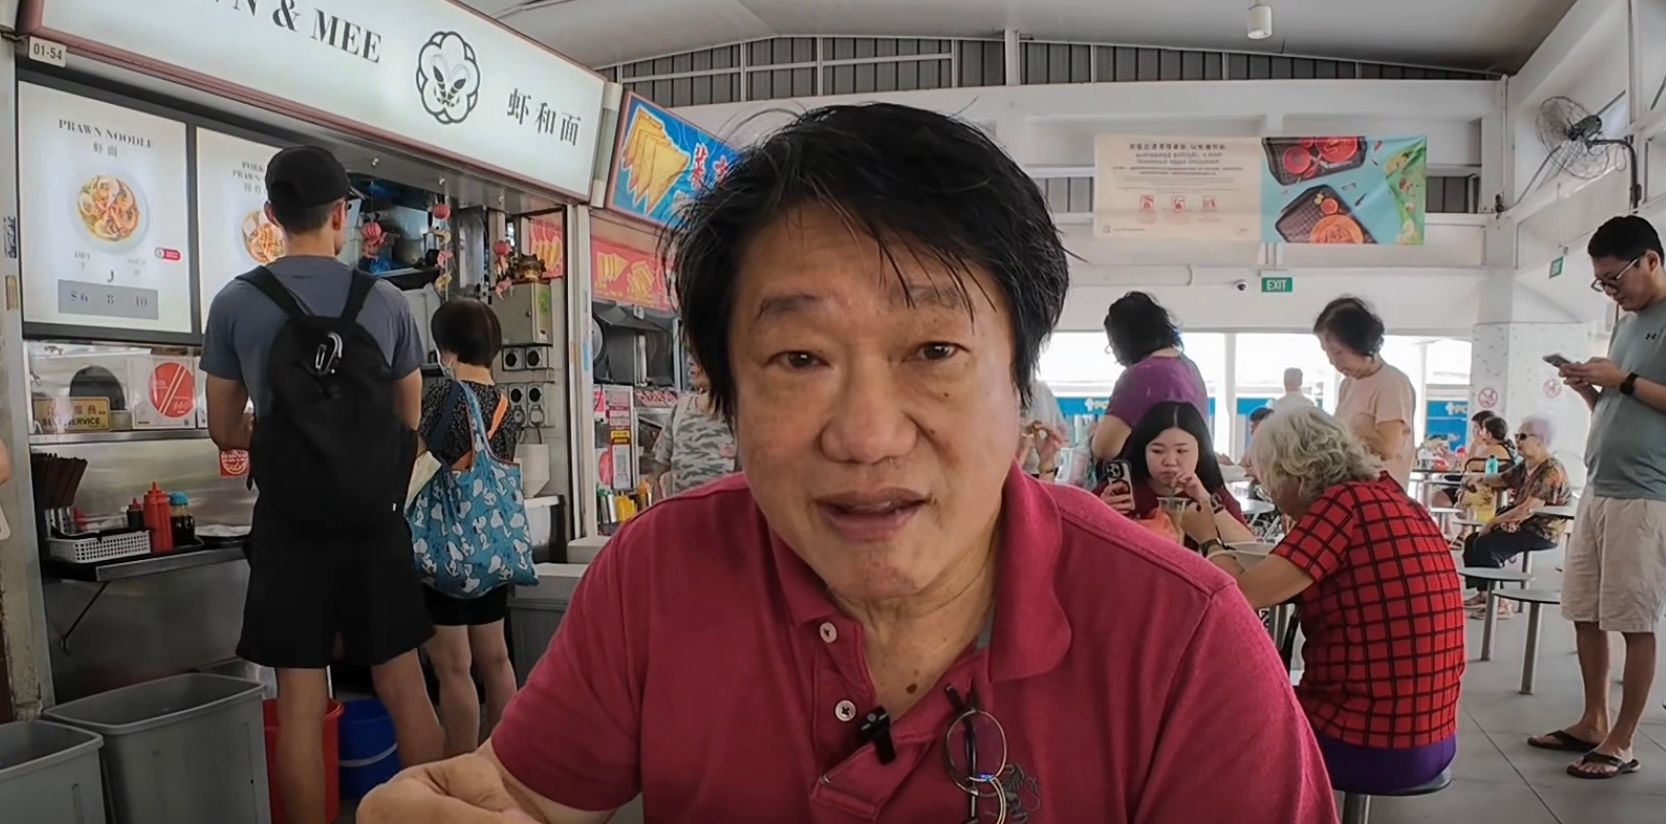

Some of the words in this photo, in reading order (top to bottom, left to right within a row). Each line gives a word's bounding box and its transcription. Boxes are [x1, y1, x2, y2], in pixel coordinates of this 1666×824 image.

[272, 0, 301, 32] &
[310, 8, 382, 63] MEE
[33, 43, 62, 60] 01-54
[506, 88, 582, 146] 虾和面
[59, 119, 102, 137] PRAWN
[106, 129, 154, 149] NOODLE
[1266, 279, 1287, 291] EXIT
